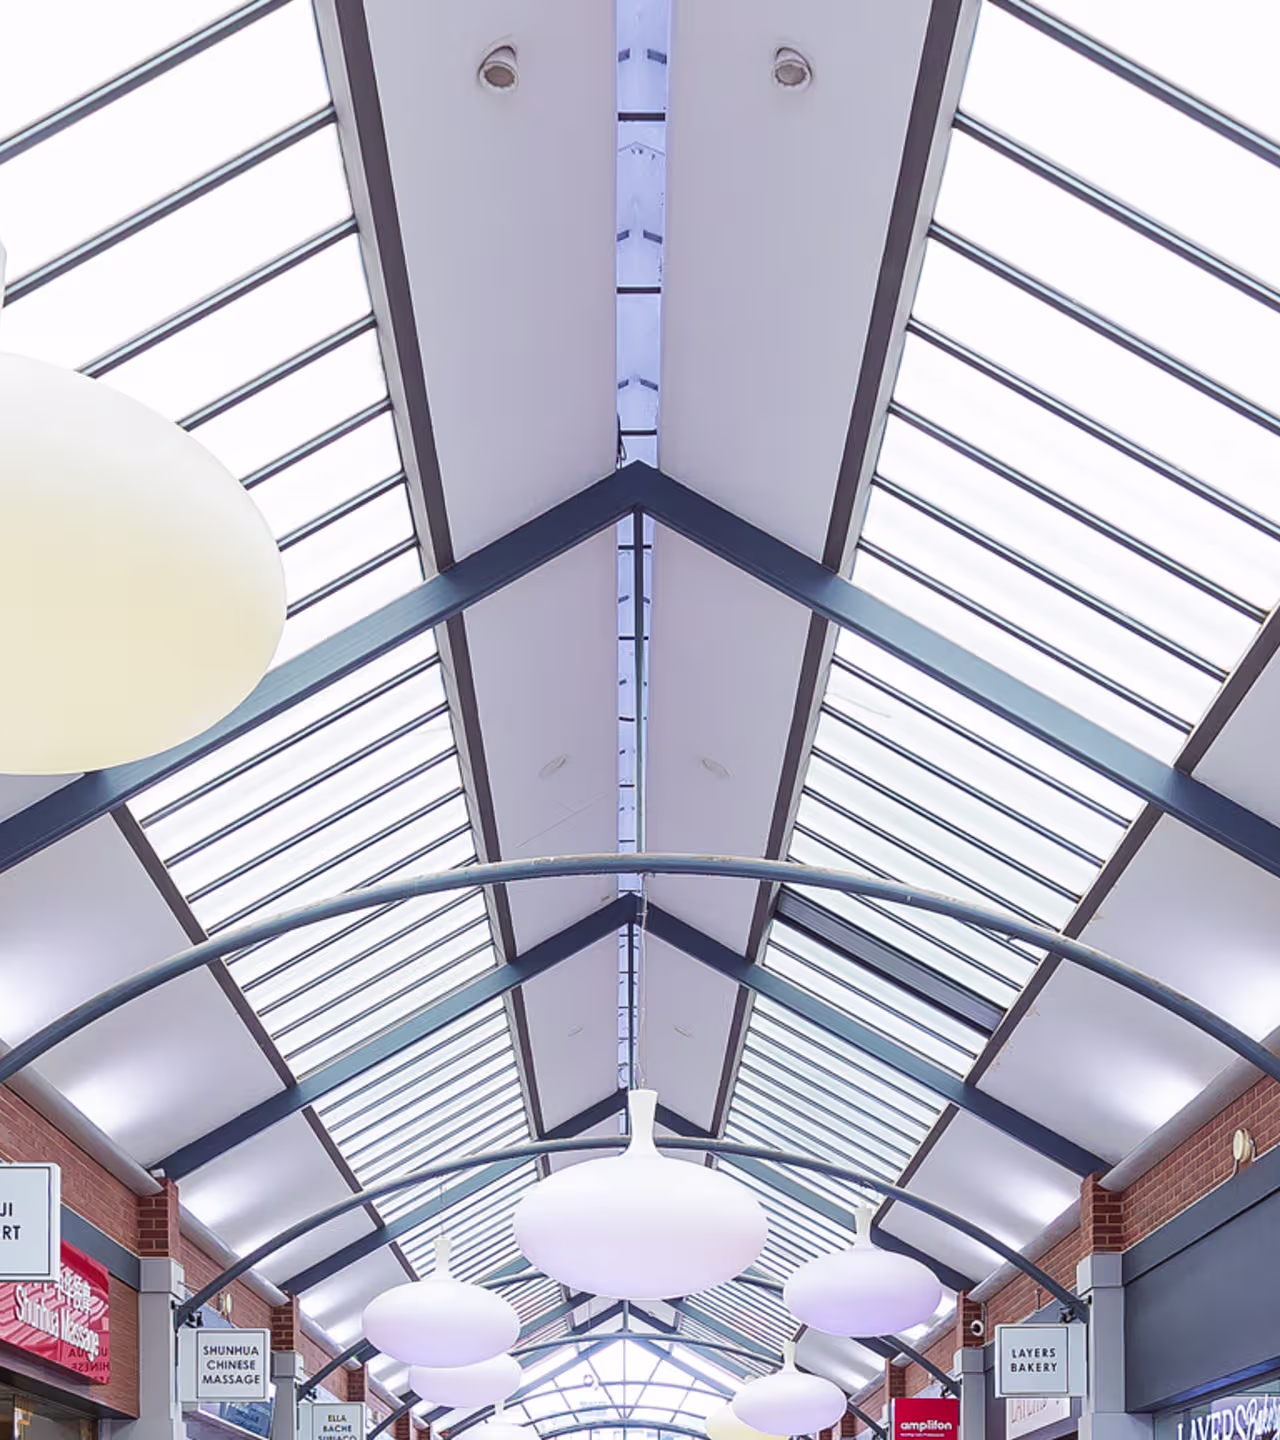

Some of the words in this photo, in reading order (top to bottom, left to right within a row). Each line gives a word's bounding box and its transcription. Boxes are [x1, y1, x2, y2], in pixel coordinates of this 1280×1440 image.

[203, 1345, 260, 1356] SHUNHUA
[1011, 1347, 1057, 1359] LAYERS
[206, 1359, 256, 1371] CHINESE
[1010, 1362, 1058, 1373] BAKERY
[201, 1373, 261, 1385] MASSAGE
[327, 1414, 347, 1423] ELLA
[899, 1419, 953, 1432] amplifon
